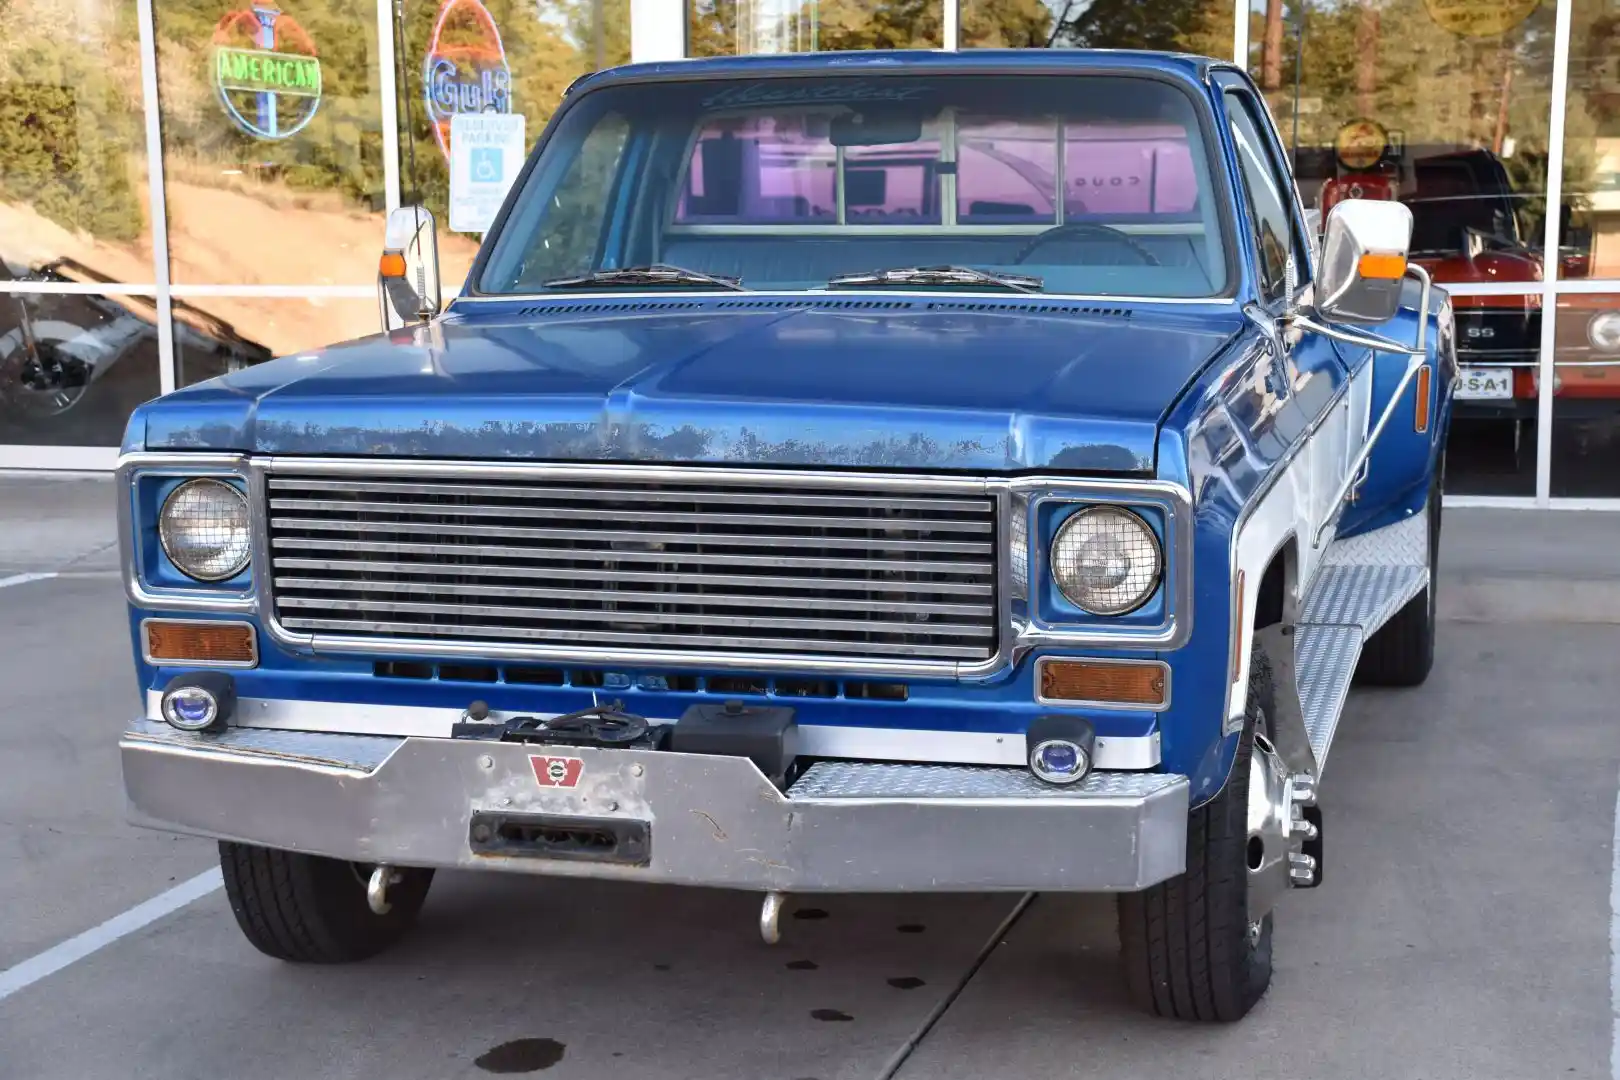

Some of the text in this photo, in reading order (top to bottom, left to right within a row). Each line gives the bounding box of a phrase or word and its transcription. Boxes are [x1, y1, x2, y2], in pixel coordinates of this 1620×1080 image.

[220, 52, 317, 89] AMERICAN
[431, 60, 508, 115] Gulf
[1467, 327, 1495, 338] SS
